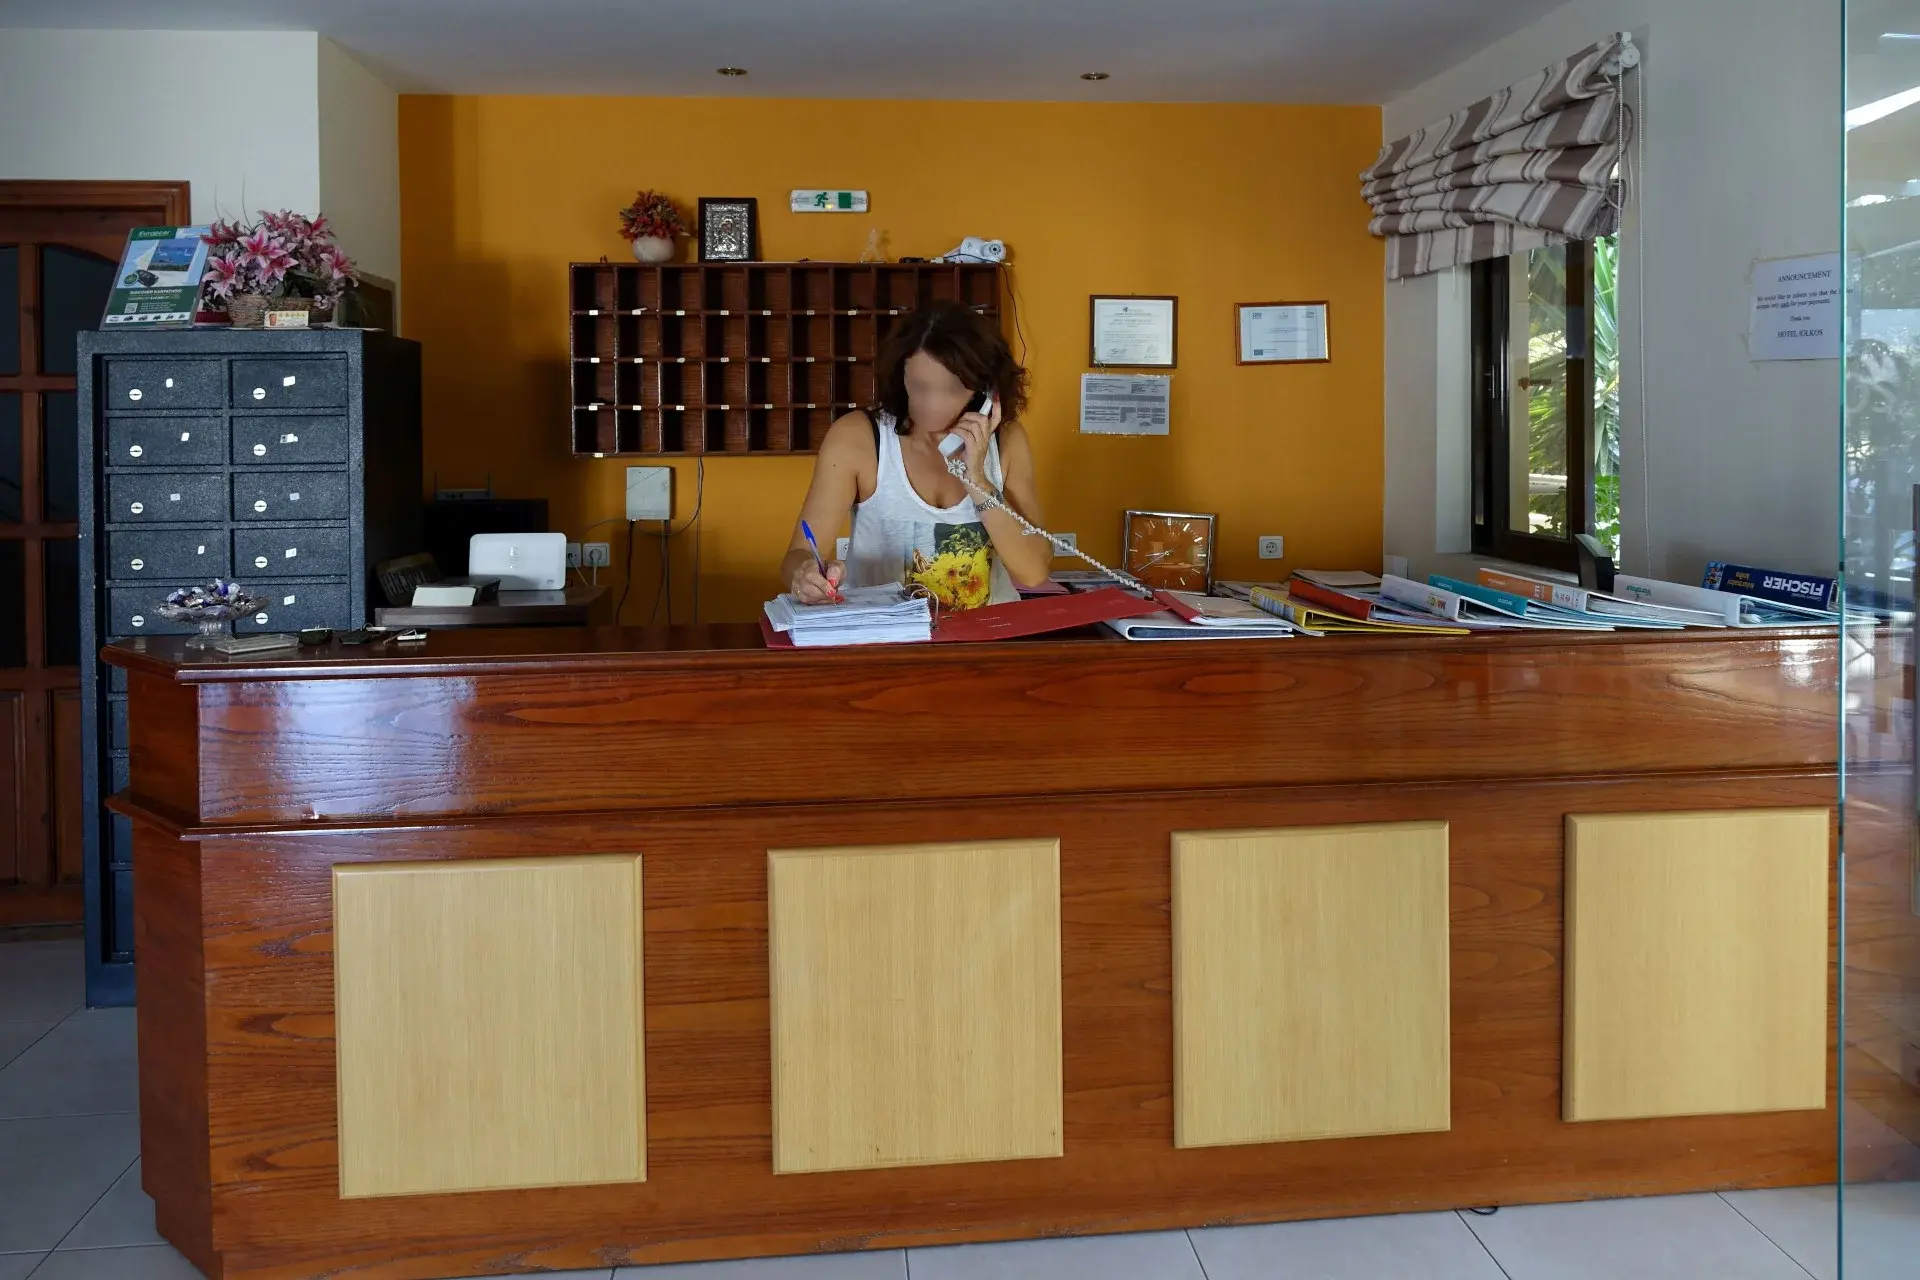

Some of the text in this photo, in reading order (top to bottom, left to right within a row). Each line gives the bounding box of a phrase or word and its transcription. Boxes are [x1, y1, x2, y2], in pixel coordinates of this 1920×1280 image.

[1778, 270, 1831, 282] ANNOUNCEMENT
[1777, 330, 1797, 338] HOTEL
[1763, 575, 1824, 596] FISCHER
